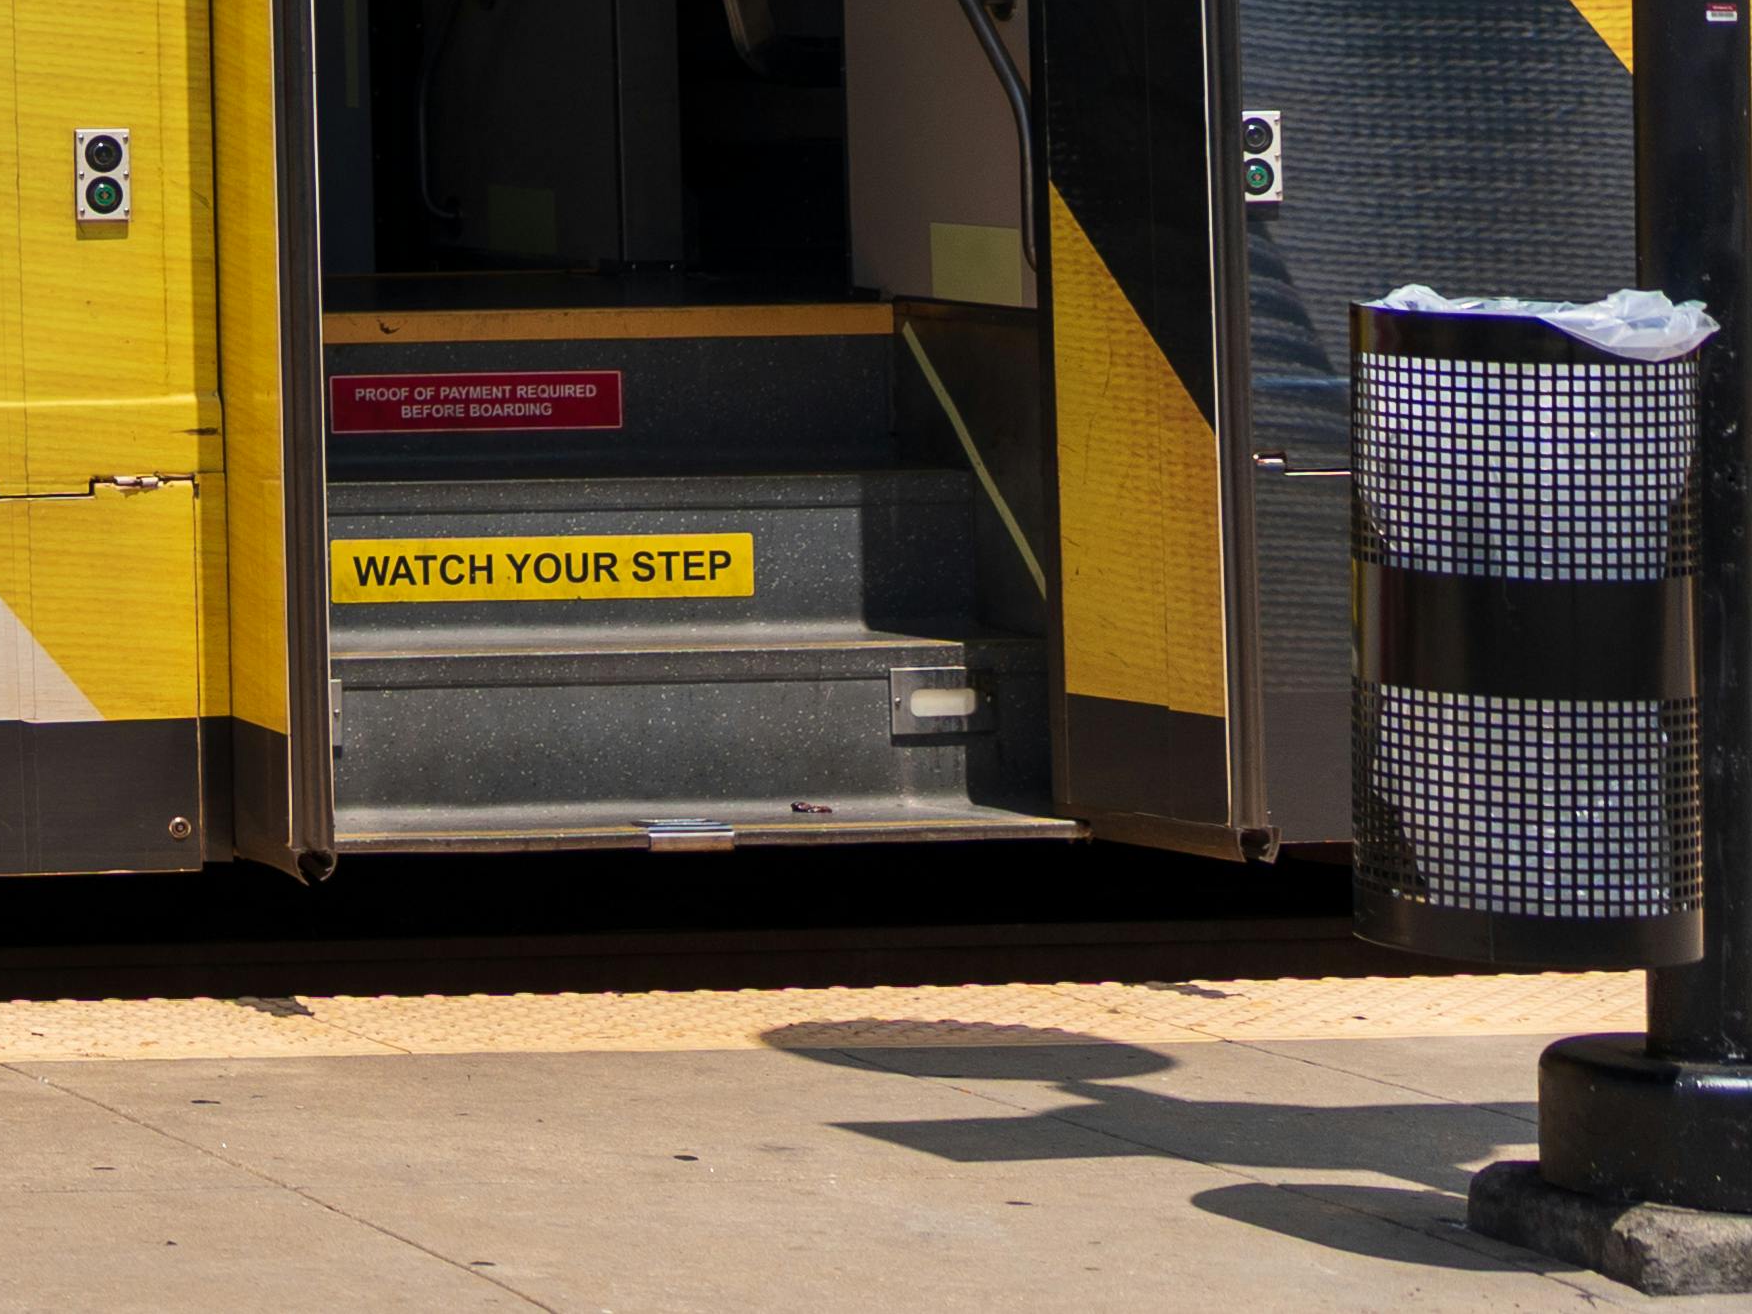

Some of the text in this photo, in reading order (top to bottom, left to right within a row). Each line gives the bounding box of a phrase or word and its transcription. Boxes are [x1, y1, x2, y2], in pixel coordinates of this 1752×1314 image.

[355, 384, 598, 402] PROOF OF PAYMENT REQUIRED
[401, 403, 553, 419] BEFORE BOARDING
[353, 550, 732, 587] WATCH YOUR STEP
